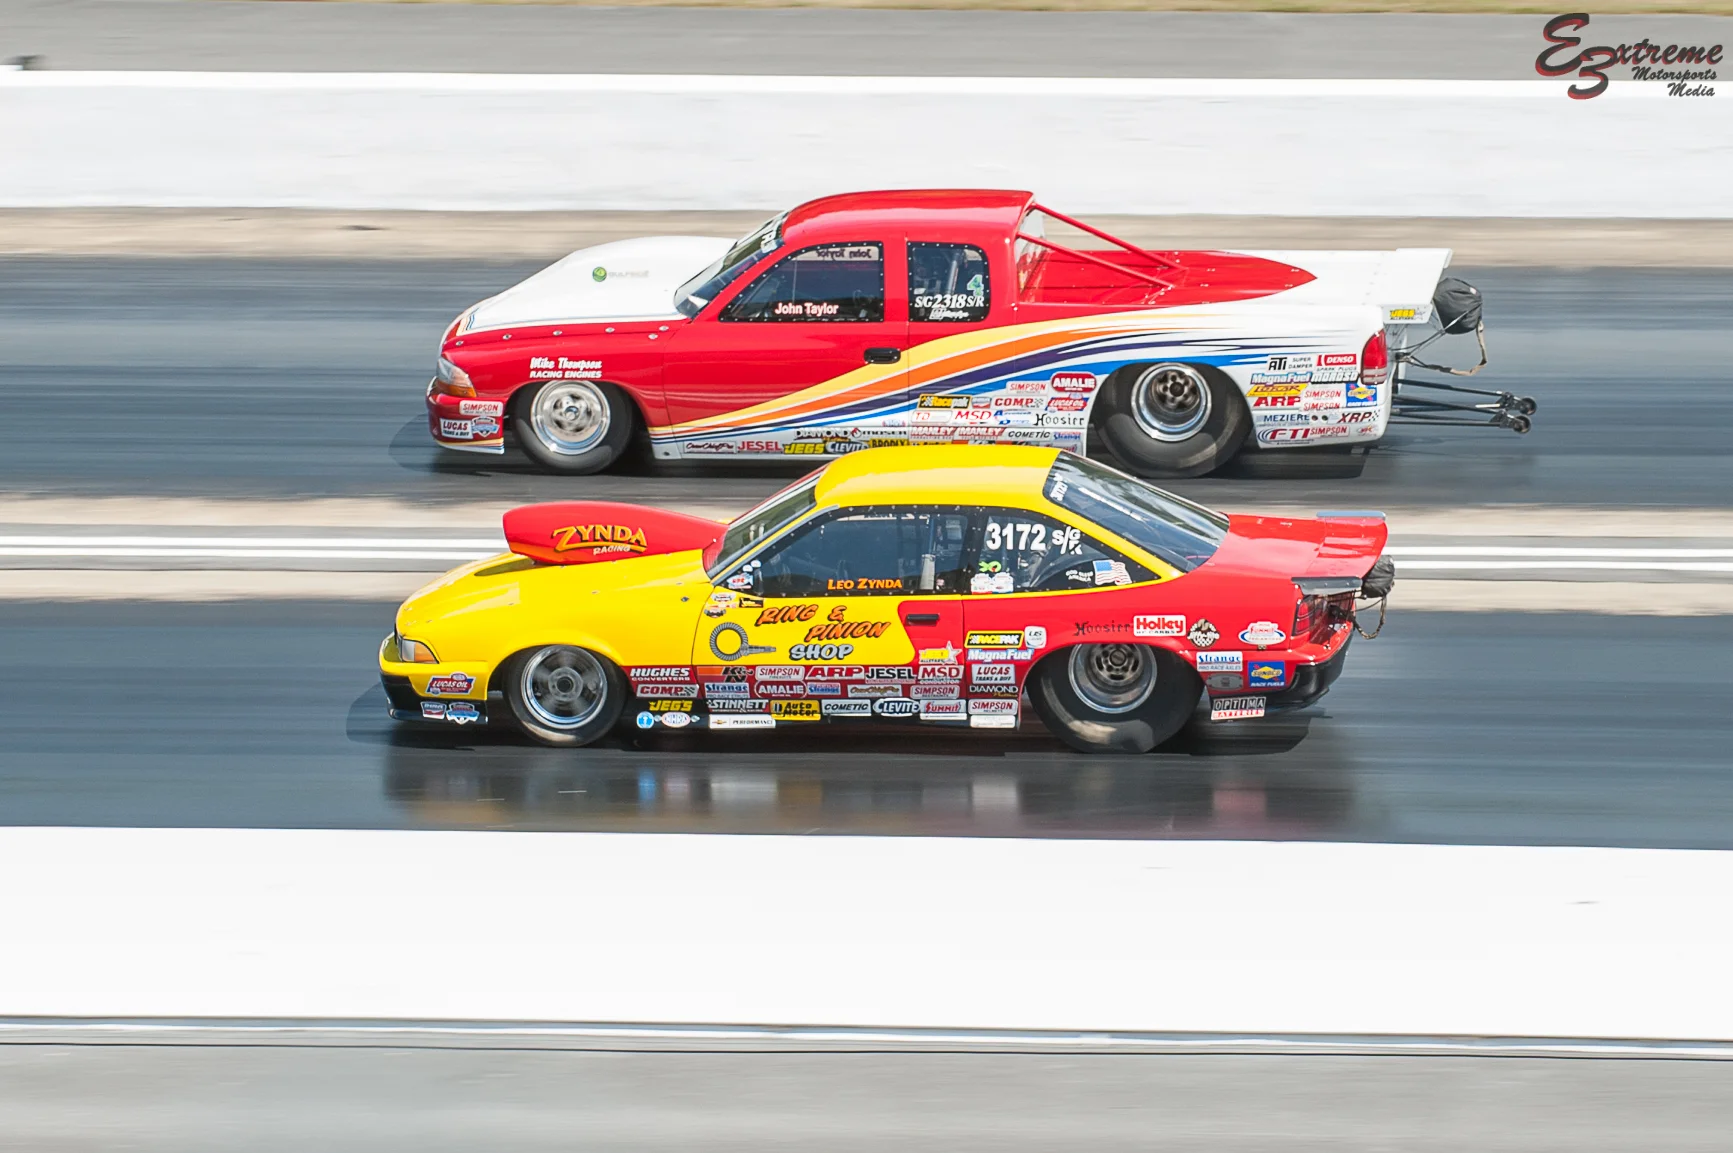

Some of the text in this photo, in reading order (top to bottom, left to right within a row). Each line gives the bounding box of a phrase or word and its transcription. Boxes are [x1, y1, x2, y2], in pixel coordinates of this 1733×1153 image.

[967, 275, 984, 296] 4
[932, 294, 967, 308] 2318
[775, 303, 839, 316] John Taylor
[530, 357, 602, 370] Mike Thompson
[1326, 355, 1354, 364] DENSO
[1053, 378, 1095, 388] AMALIE
[1251, 371, 1311, 386] MagnaFuel
[1010, 383, 1046, 391] SIMPSON
[994, 398, 1034, 407] COMP
[1253, 397, 1301, 407] ARP
[1303, 402, 1340, 411] SIMPSON
[462, 403, 499, 412] SIMPSON
[955, 411, 992, 420] MSD
[1264, 413, 1310, 422] MEZIERE
[1338, 412, 1373, 423] XRP
[443, 422, 468, 431] LUCAS
[911, 427, 953, 436] MANLEY
[960, 427, 1000, 436] MANLEY
[1310, 426, 1348, 435] SIMPSON
[796, 429, 850, 438] DIAMOND
[1269, 428, 1310, 440] FTI
[738, 441, 781, 451] JESEL
[552, 524, 647, 553] ZYNDA
[986, 523, 1047, 551] 3172
[593, 545, 631, 555] RACING
[827, 578, 903, 590] LEO ZYNDA
[755, 604, 819, 626] RING
[828, 605, 847, 622] &
[1137, 618, 1184, 633] Holley
[804, 621, 891, 642] PINION
[789, 644, 854, 660] SHOP
[967, 648, 1034, 663] MagnaFuel
[630, 668, 690, 677] HUGHES
[760, 668, 800, 676] SIMPSON
[808, 667, 862, 677] ARP
[866, 668, 916, 679] JESEL
[922, 667, 960, 678] MSD
[977, 667, 1010, 675] LUCAS
[432, 680, 456, 688] LUCAS
[640, 685, 684, 695] COMP
[758, 685, 804, 694] AMALIE
[708, 700, 769, 709] STINNETT
[924, 702, 960, 712] Summit
[972, 701, 1013, 710] SIMPSON
[1215, 698, 1265, 710] OPTIMA
